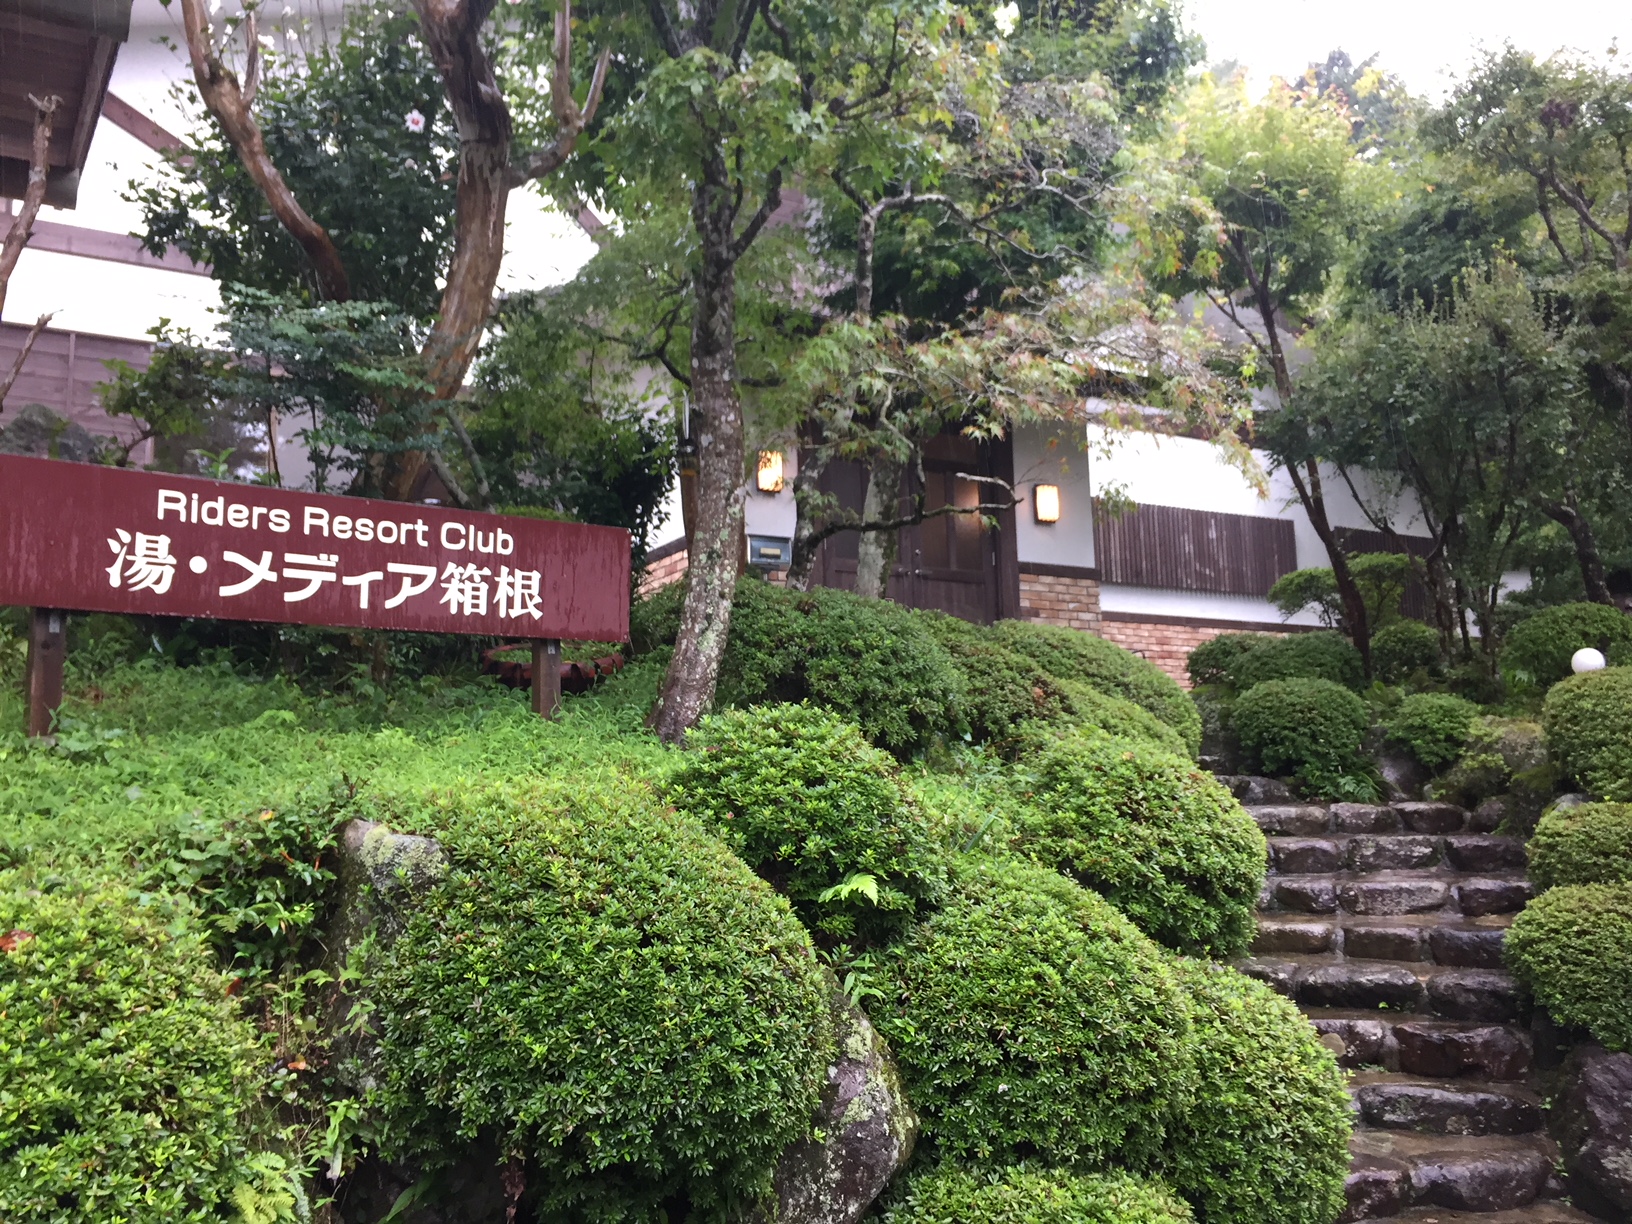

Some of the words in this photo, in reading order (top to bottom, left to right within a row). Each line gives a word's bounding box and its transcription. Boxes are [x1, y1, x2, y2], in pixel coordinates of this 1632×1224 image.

[156, 488, 291, 533] Riders
[303, 505, 429, 548] Resort
[440, 521, 515, 556] Club
[105, 527, 544, 621] 湯・メディア箱根
